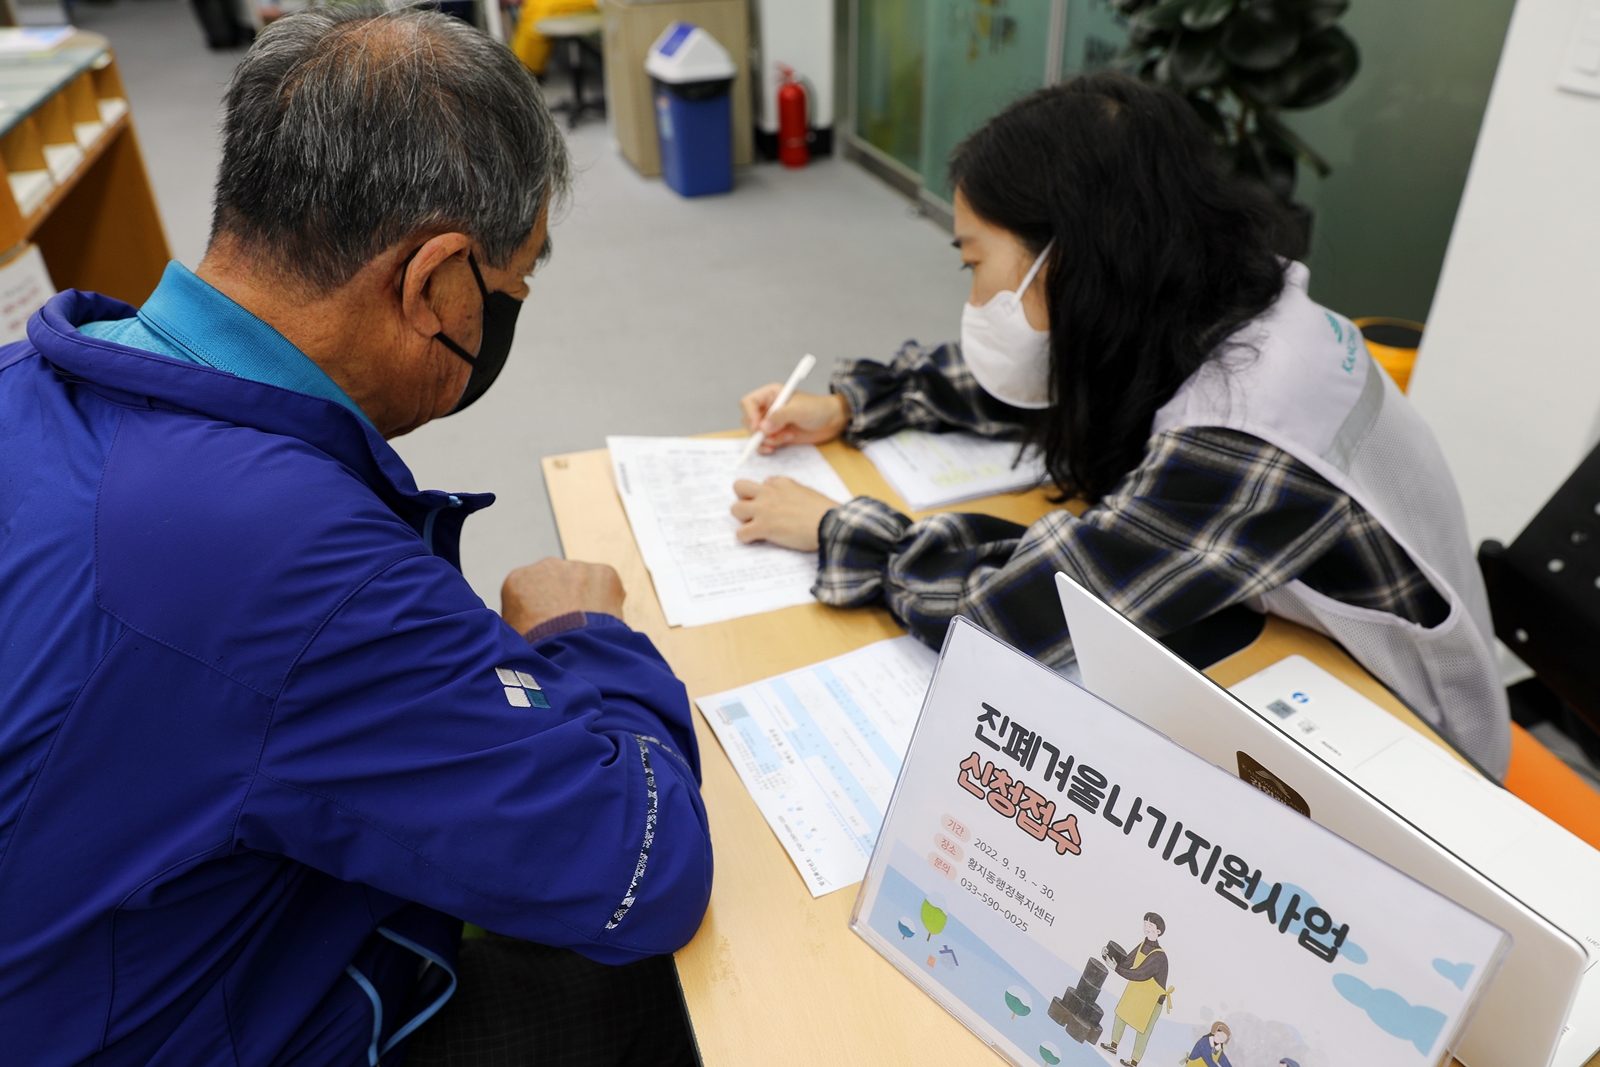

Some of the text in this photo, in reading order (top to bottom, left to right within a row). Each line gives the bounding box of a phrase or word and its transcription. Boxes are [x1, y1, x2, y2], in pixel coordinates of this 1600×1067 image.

[947, 819, 965, 837] 기간
[957, 751, 1082, 856] 신청접수
[974, 702, 1350, 963] 진폐겨울나기지원사업
[934, 857, 951, 875] 문의
[940, 838, 957, 856] 장소
[974, 837, 998, 862] 2022.
[1001, 857, 1010, 870] 9.
[1014, 866, 1027, 882] 19.
[1039, 884, 1055, 902] 30.
[960, 877, 1029, 932] 033-590-0025
[967, 857, 1056, 927] 황지동행정복지센터
